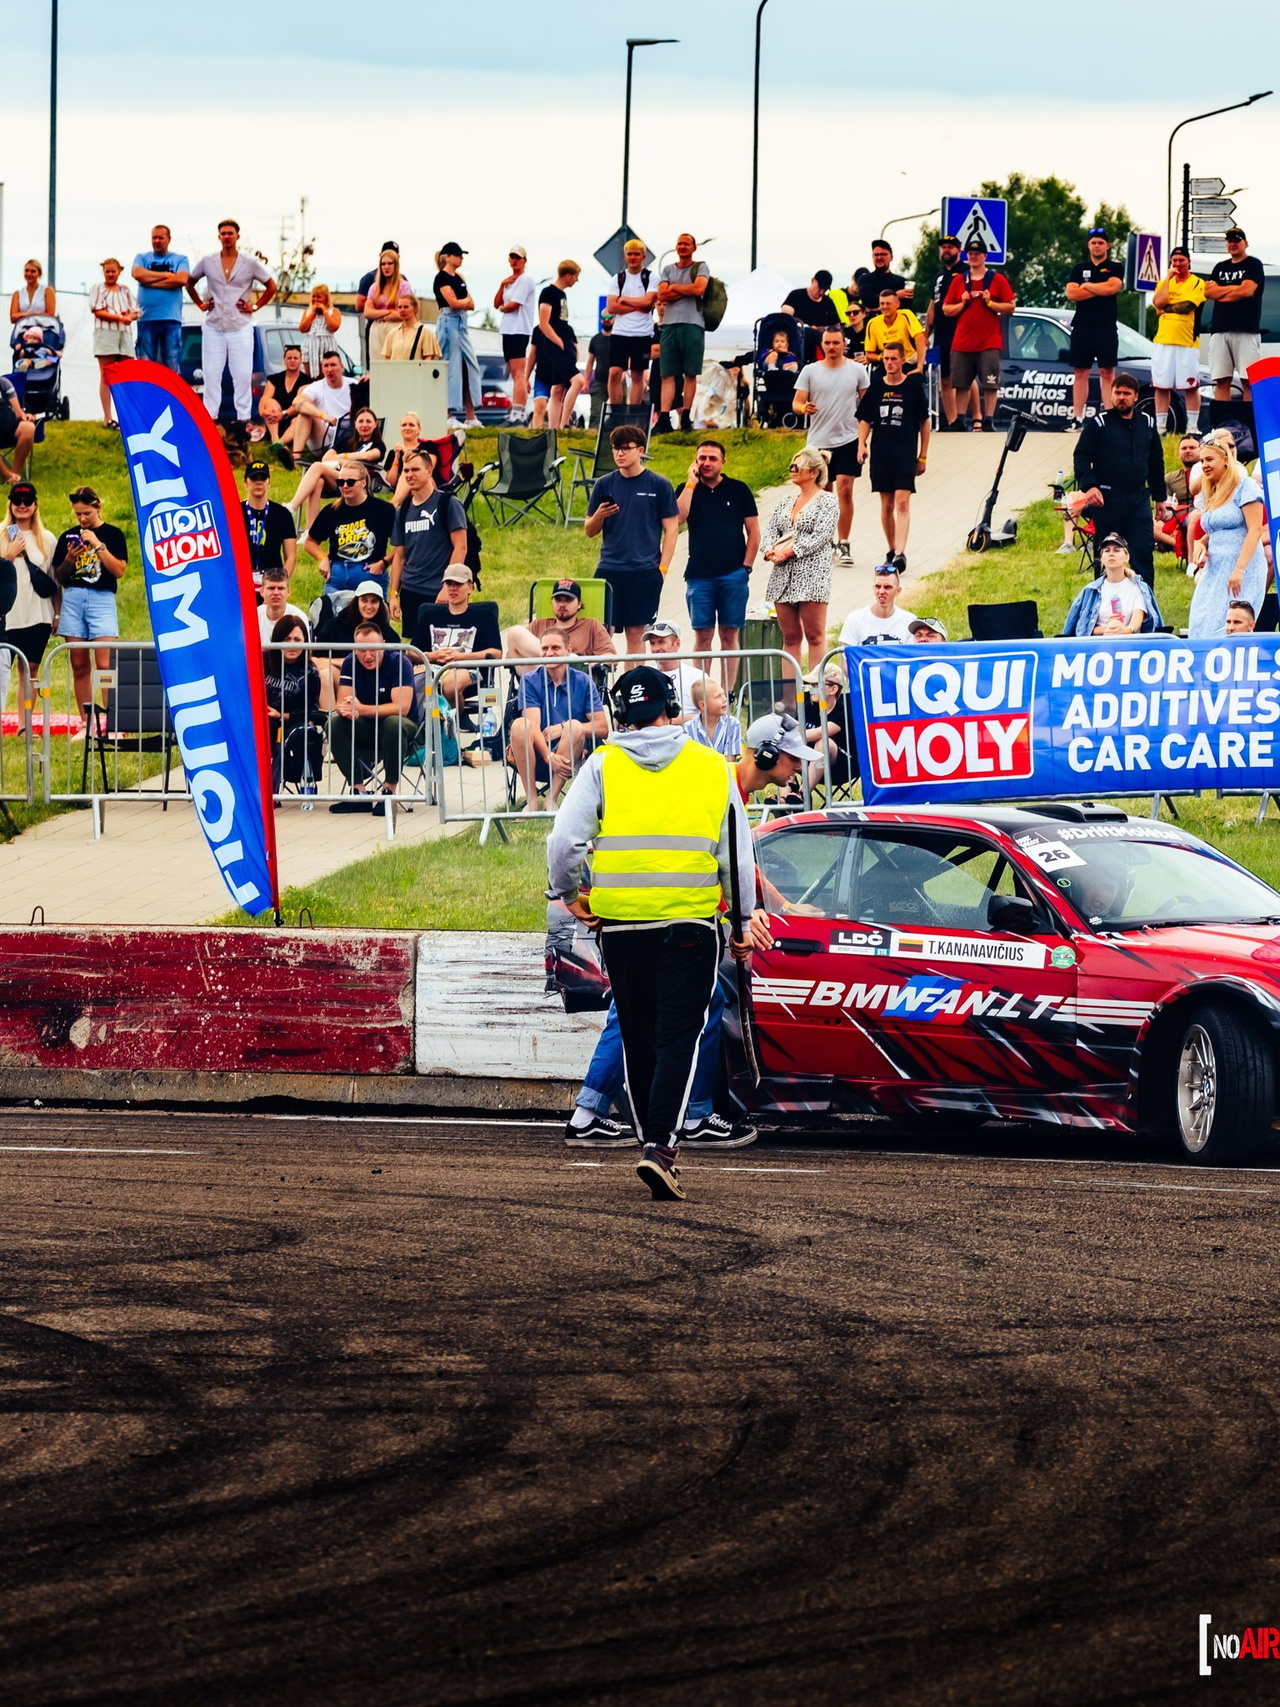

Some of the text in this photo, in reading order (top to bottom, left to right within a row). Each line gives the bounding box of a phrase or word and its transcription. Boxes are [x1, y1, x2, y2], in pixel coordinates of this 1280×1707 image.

[1021, 369, 1076, 386] Kauno
[996, 383, 1067, 401] echnikos
[1030, 401, 1097, 420] Kolegja
[339, 518, 366, 532] TIME
[404, 518, 430, 534] PUMA
[337, 531, 369, 547] DRIFT
[1051, 648, 1195, 688] MOTOR
[868, 658, 1027, 718] LIQUI
[1061, 688, 1280, 730] ADDITIVES
[874, 717, 1028, 779] MOLY
[1067, 730, 1275, 773] CAR CARE
[1038, 849, 1071, 863] 26
[837, 930, 884, 946] LDČ
[928, 940, 1025, 962] T.KANANAVIČIUS
[808, 980, 1071, 1020] BMWFAN.LT
